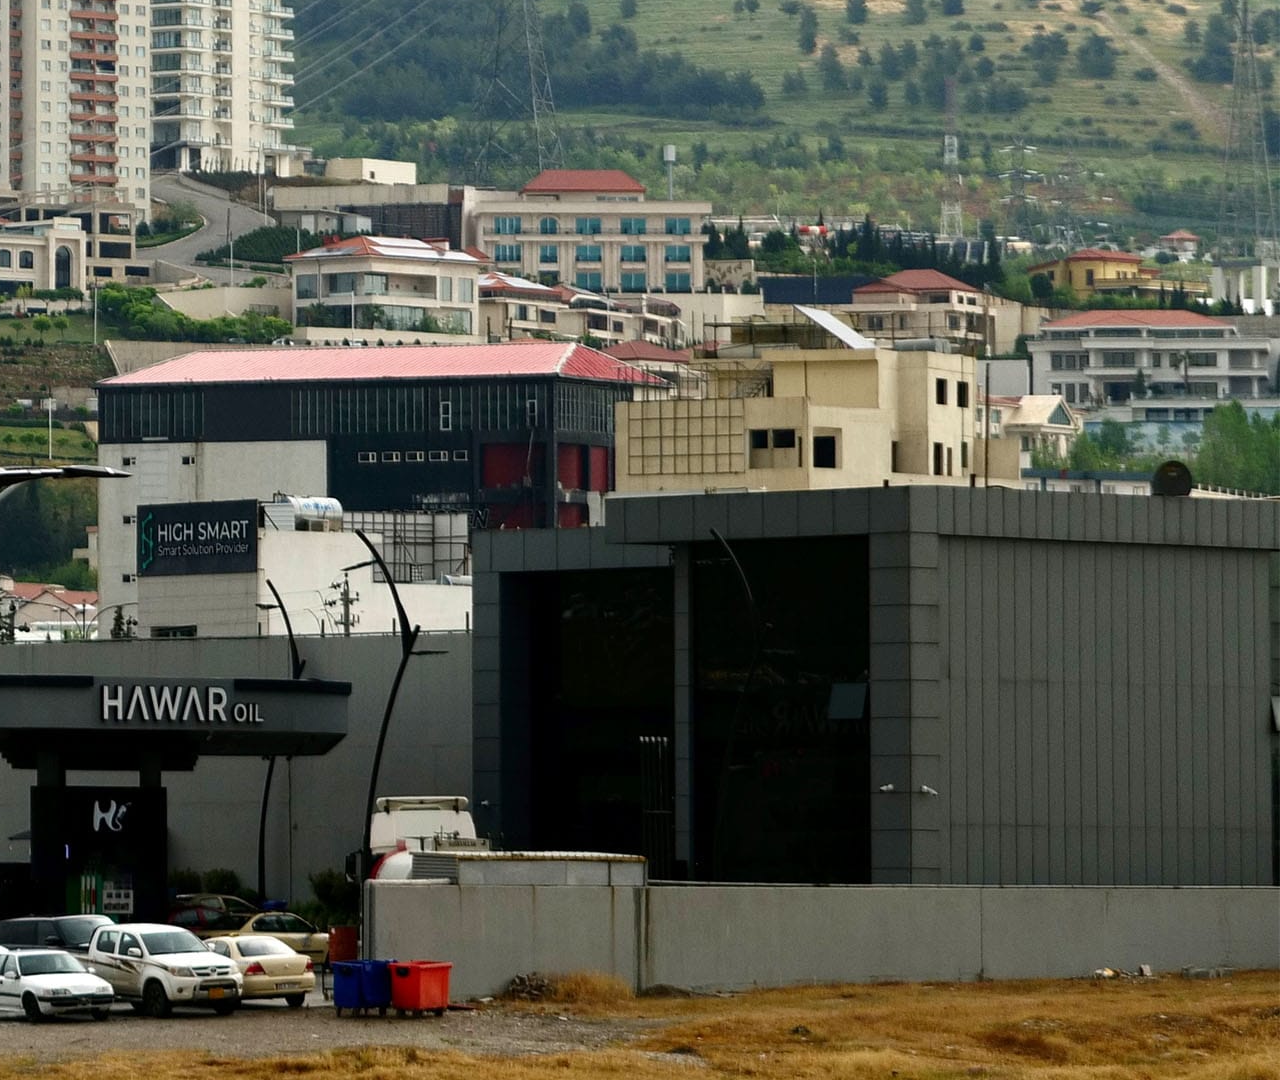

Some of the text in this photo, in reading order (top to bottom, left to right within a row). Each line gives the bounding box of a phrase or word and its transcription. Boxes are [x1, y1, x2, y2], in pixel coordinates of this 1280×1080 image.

[157, 520, 249, 542] HIGH SMART
[158, 542, 249, 556] Smart Solution Provider
[103, 685, 265, 722] HAWAR OIL
